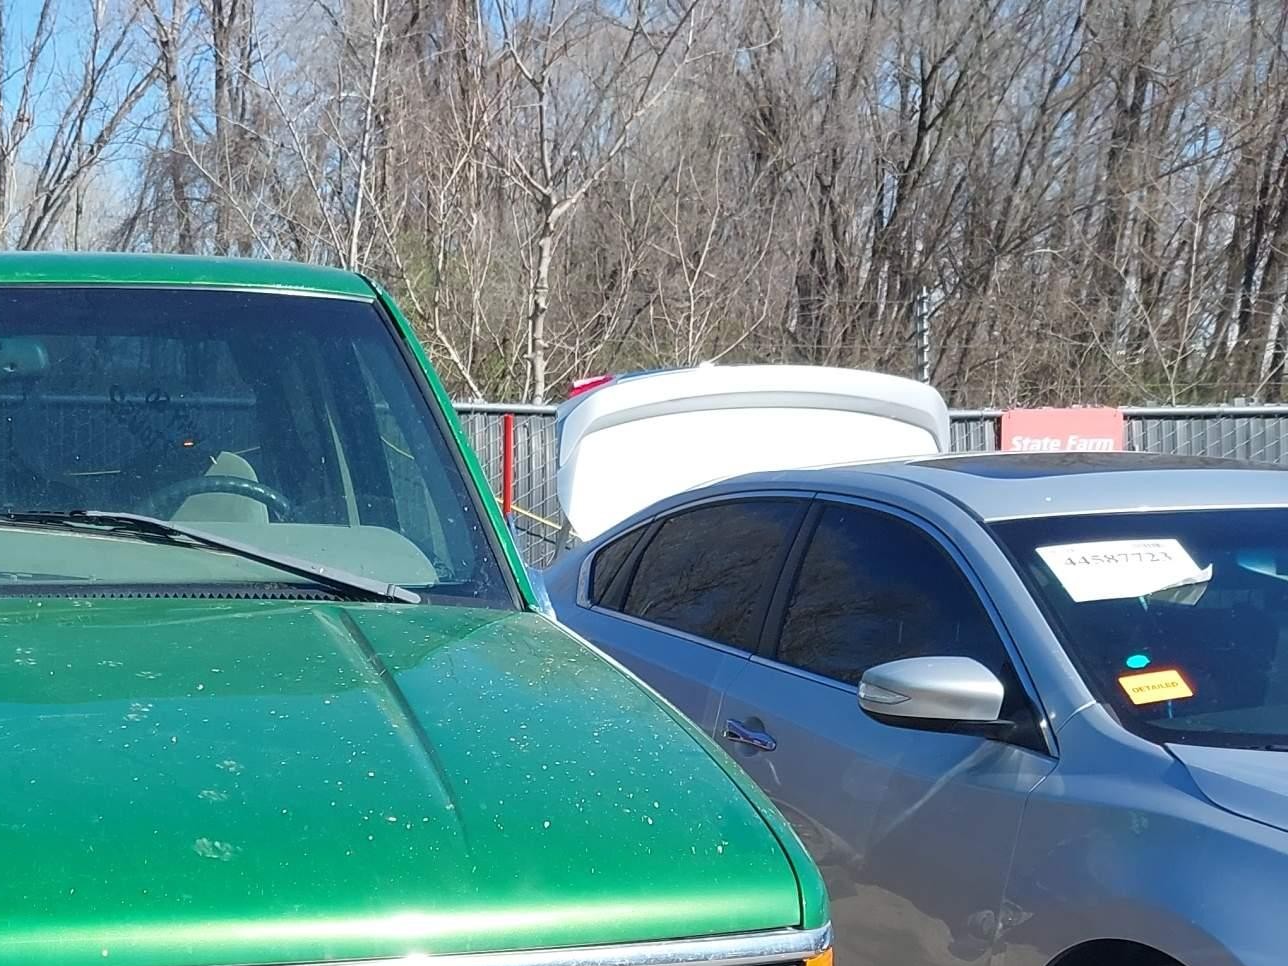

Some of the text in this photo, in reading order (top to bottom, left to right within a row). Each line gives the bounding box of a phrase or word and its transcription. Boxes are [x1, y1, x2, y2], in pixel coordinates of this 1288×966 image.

[1009, 434, 1115, 451] State Farm
[1064, 552, 1172, 567] 44587723
[1131, 681, 1179, 694] DETAILED
